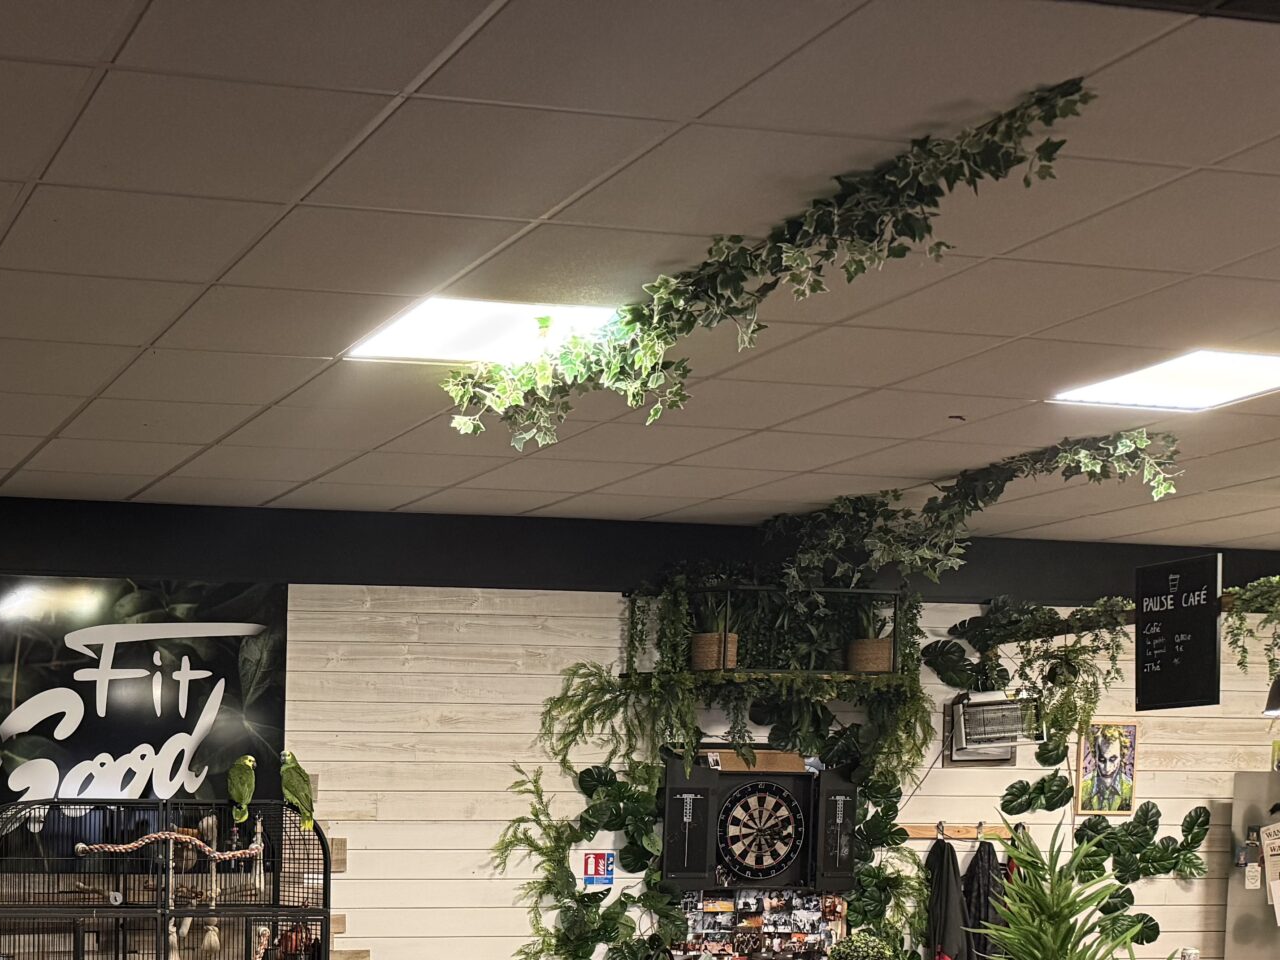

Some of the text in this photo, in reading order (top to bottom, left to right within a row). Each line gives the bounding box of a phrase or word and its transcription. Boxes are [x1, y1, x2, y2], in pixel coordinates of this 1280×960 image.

[1143, 585, 1207, 613] PAUSE CAFÉ
[64, 622, 267, 719] Fit
